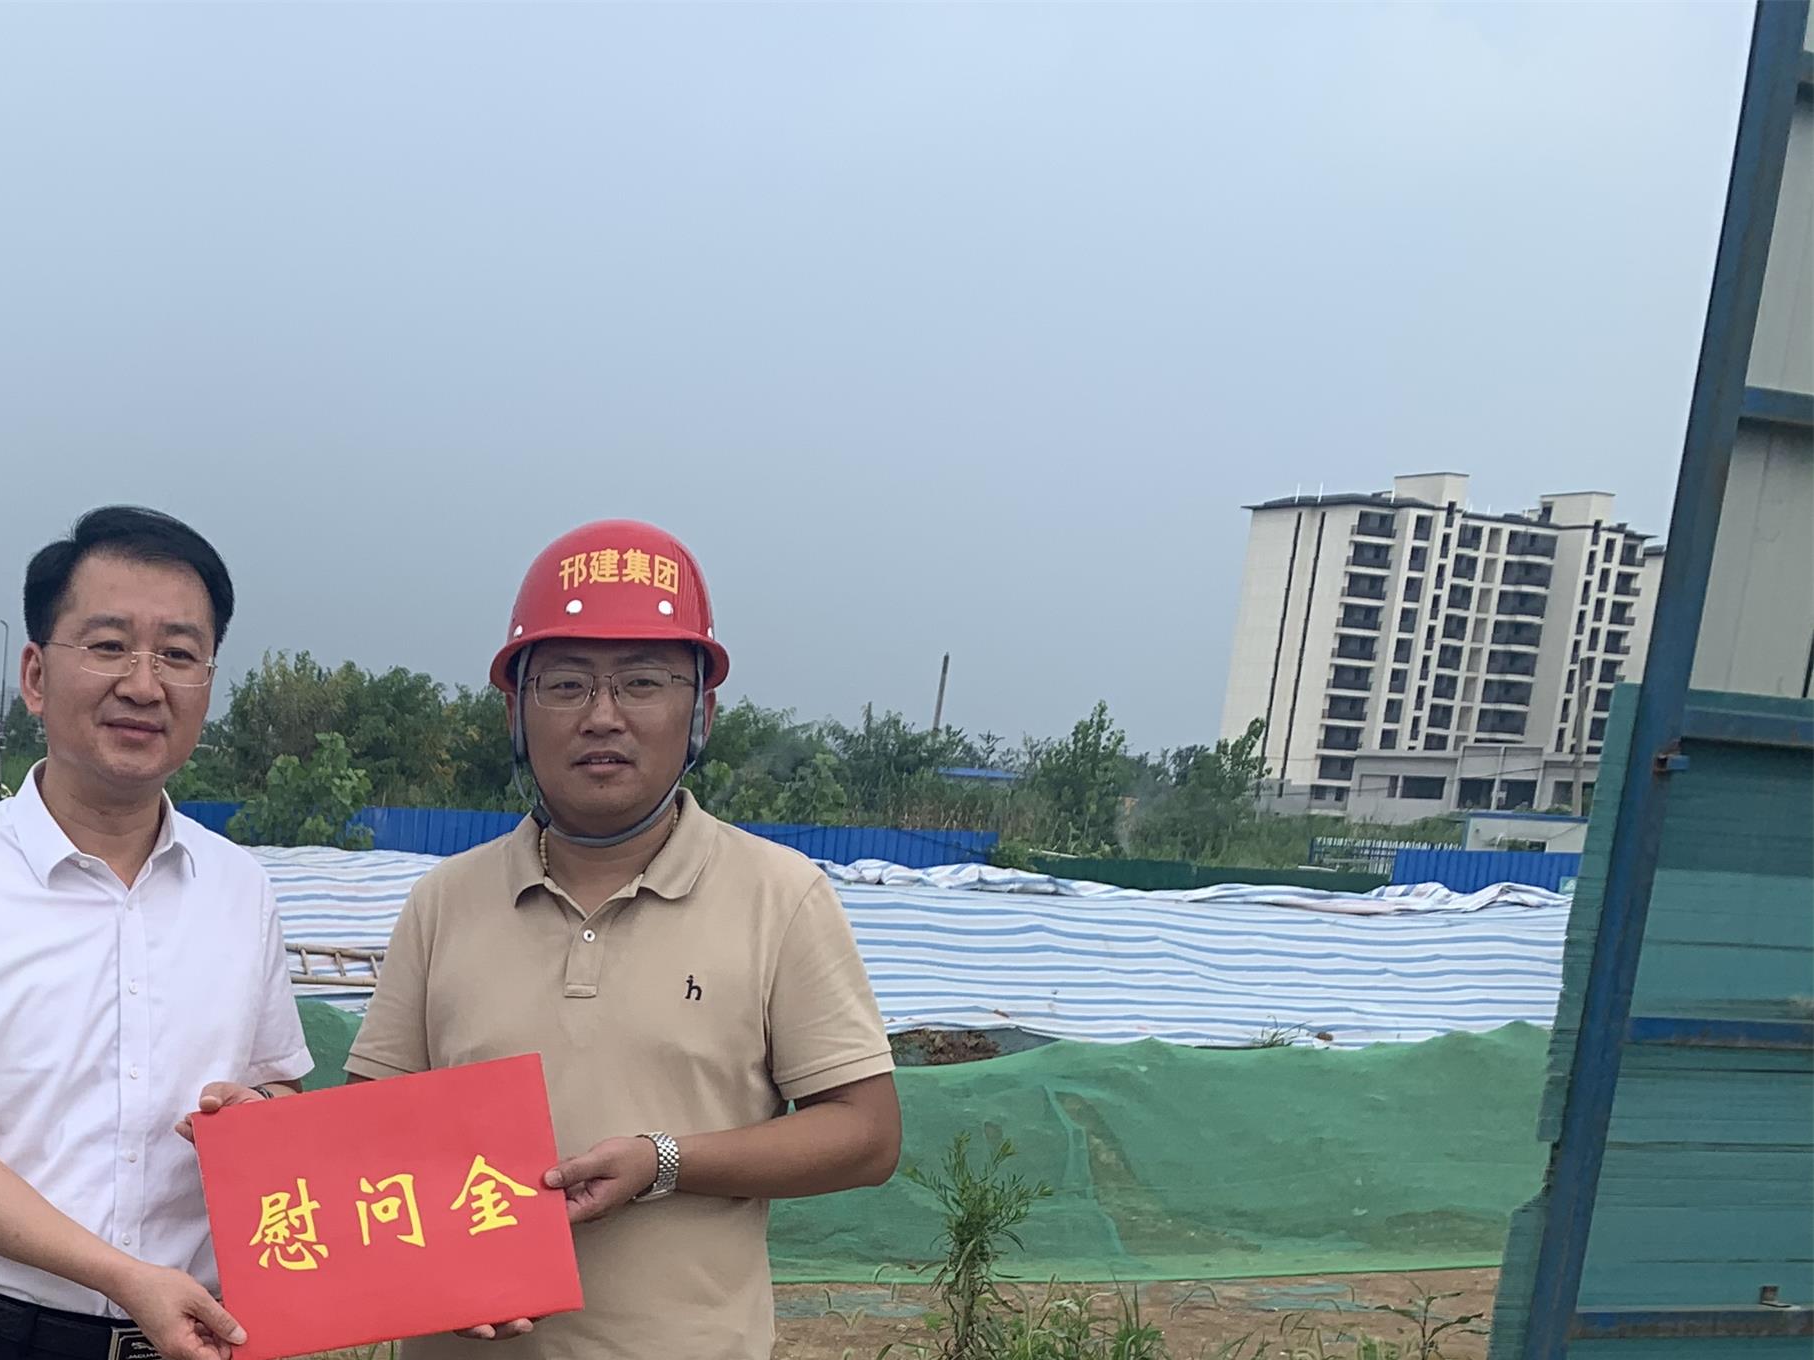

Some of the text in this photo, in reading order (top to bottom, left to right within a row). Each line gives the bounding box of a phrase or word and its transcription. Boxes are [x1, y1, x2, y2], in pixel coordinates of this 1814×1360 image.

[559, 548, 679, 594] 邗建集团
[249, 1154, 538, 1270] 慰问金
